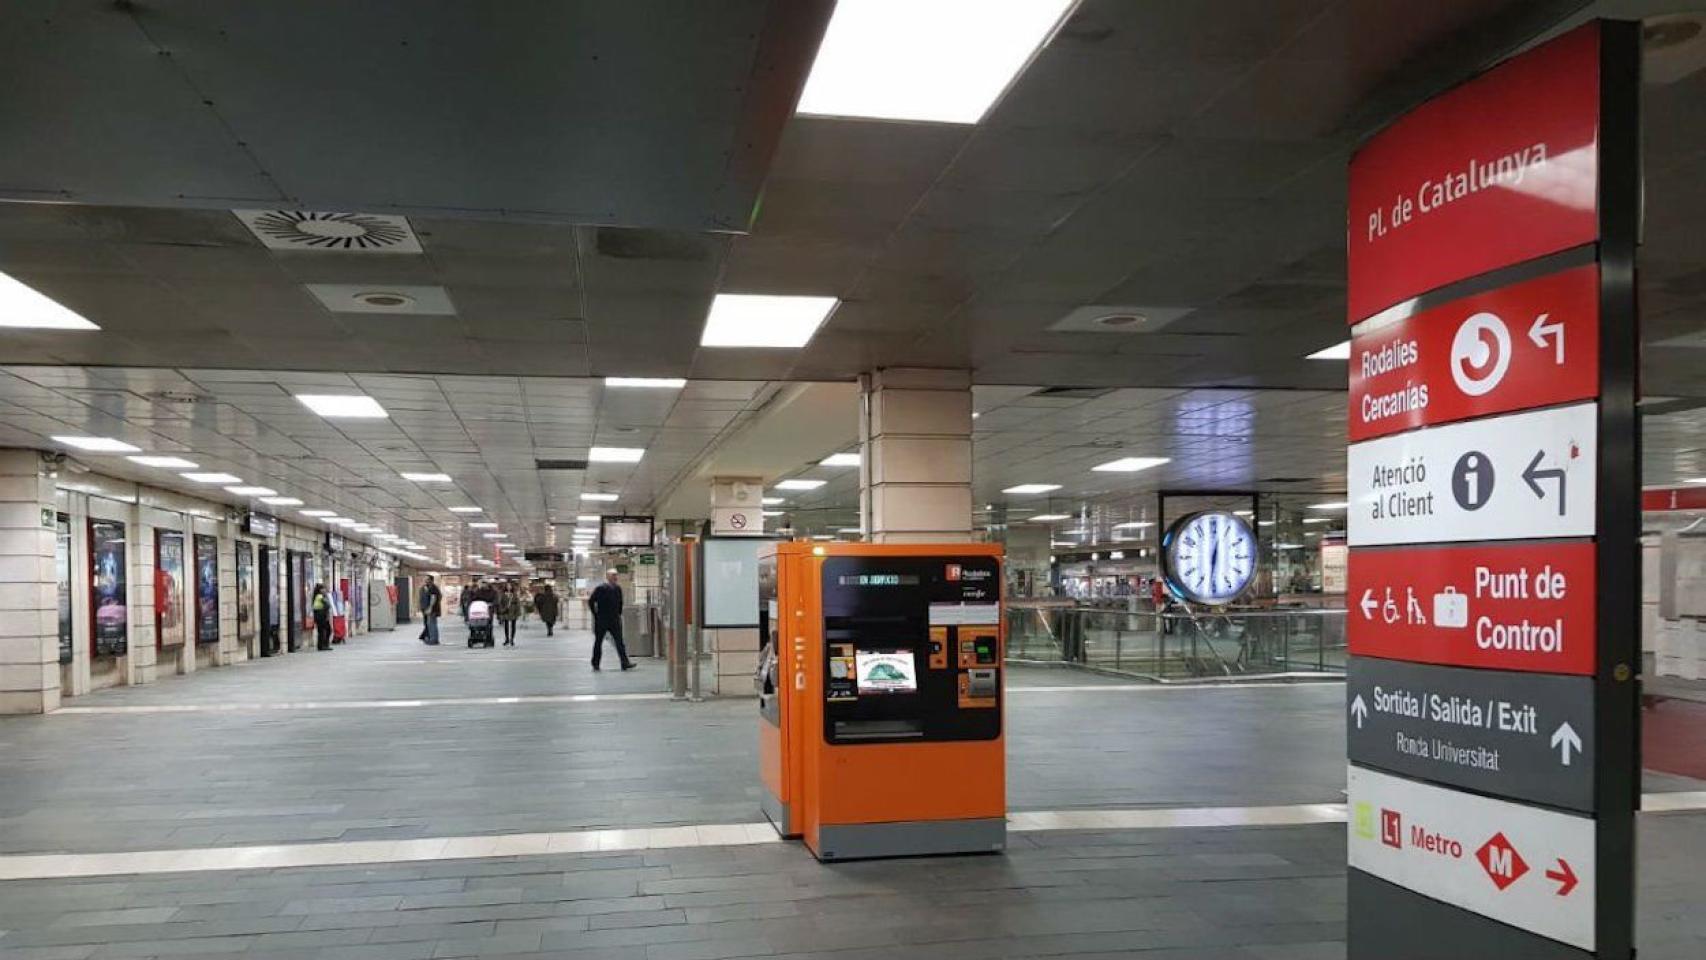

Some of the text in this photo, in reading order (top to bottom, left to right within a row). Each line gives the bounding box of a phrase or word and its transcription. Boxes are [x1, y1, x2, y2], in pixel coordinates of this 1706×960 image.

[1368, 142, 1547, 243] Pl. de Catalunya
[1362, 339, 1418, 379] Rodalies
[1362, 380, 1429, 423] Cercanías
[1372, 456, 1426, 489] Atenció
[1372, 491, 1434, 519] al Client
[1475, 564, 1567, 599] Punt de
[1476, 616, 1563, 652] Control
[1373, 686, 1419, 718] Sortida
[1430, 694, 1483, 728] Salida
[1498, 701, 1538, 735] Exit
[1396, 731, 1500, 771] Ronda Universitat
[1383, 813, 1399, 845] L1
[1411, 824, 1462, 858] Metro
[1488, 844, 1513, 879] M
